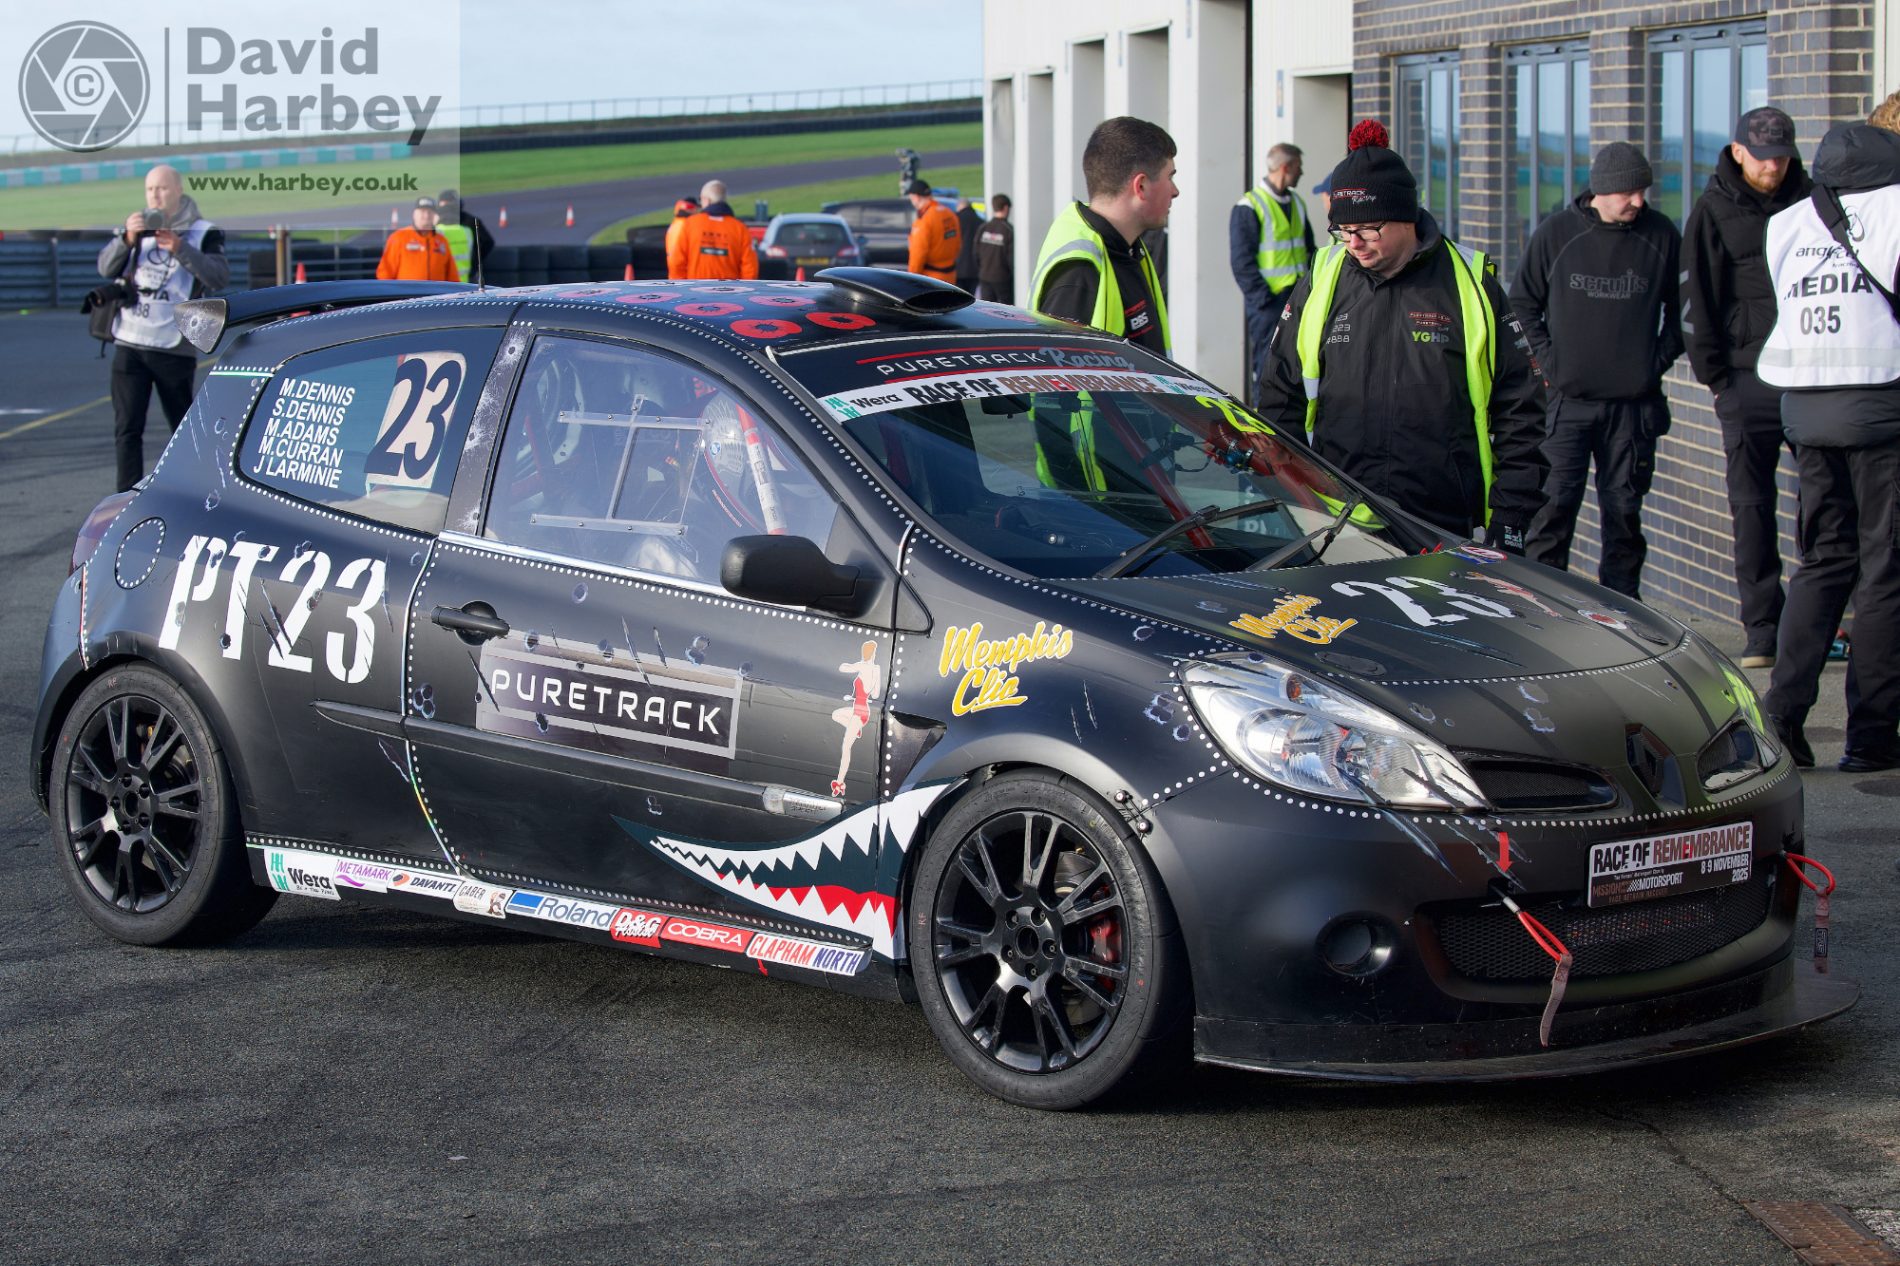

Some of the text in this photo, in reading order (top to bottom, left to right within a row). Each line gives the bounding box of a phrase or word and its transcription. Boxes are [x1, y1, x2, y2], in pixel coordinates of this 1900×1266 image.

[1800, 305, 1841, 336] 035
[876, 347, 1135, 376] PURETRACK Racing
[279, 378, 355, 406] M.DENNIS
[849, 393, 903, 409] Wera
[902, 374, 1165, 405] RACE OF REMEMBRANCE
[272, 398, 346, 426] S.DENNIS
[364, 358, 462, 480] 23
[264, 418, 339, 446] M.ADAMS
[258, 435, 344, 468] M.CURRAN
[253, 455, 342, 488] J LARMINIE
[158, 535, 387, 684] PT23
[1330, 576, 1517, 627] 23
[939, 621, 1073, 677] Memphis
[491, 668, 721, 735] PURETRACK
[952, 667, 1028, 717] Clio
[1593, 824, 1750, 874] RACE OF REMEMBRANCE
[1713, 853, 1749, 873] NOVEMBER
[287, 867, 332, 890] Wera
[337, 861, 391, 881] METAMARK
[410, 877, 456, 893] DAVANTI
[1638, 872, 1684, 891] MOTORSPORT
[1732, 868, 1749, 882] 2025
[537, 897, 615, 928] Roland
[614, 911, 662, 932] D&G
[667, 922, 742, 947] COBRA
[749, 935, 861, 973] CLAPHAM NORTH
